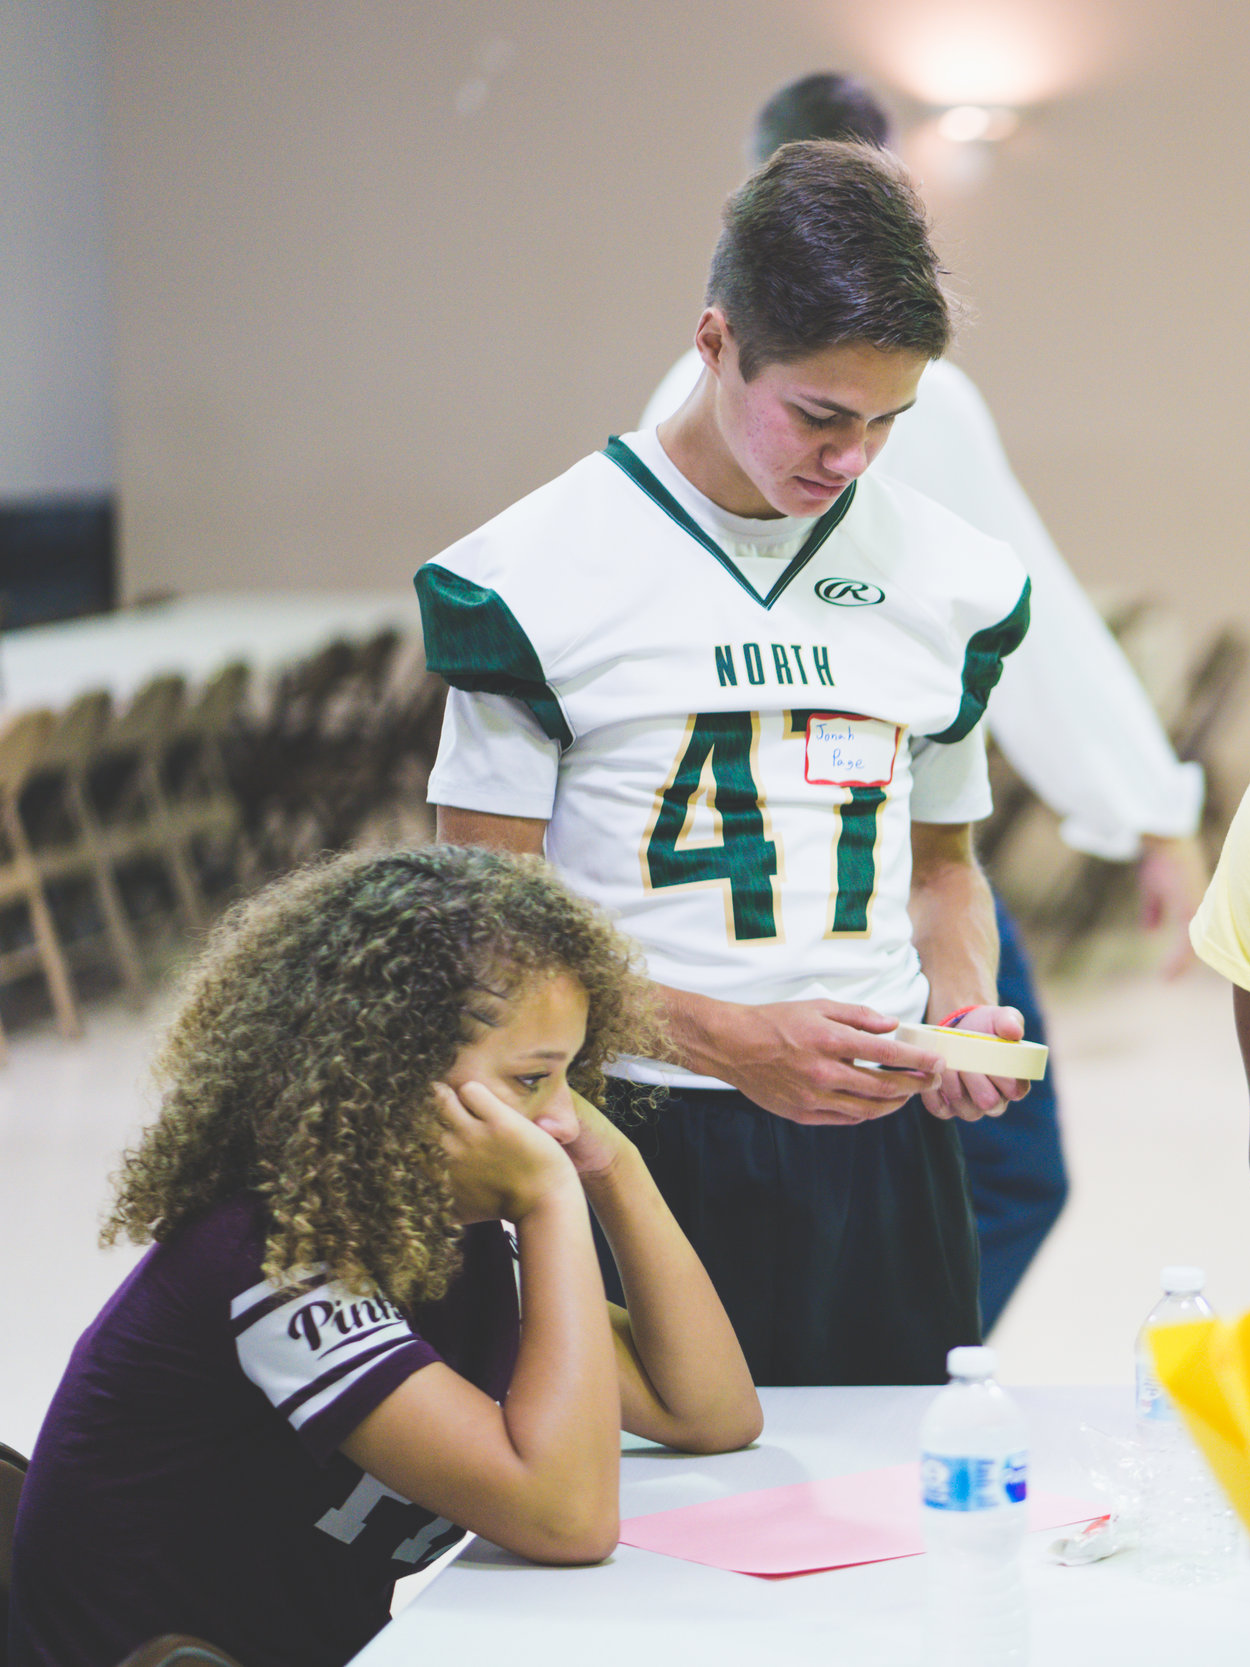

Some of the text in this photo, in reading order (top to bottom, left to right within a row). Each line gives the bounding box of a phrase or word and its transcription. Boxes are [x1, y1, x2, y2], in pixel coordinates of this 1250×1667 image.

[713, 642, 836, 689] NORTH
[815, 723, 855, 742] Jonah
[832, 748, 865, 770] Page
